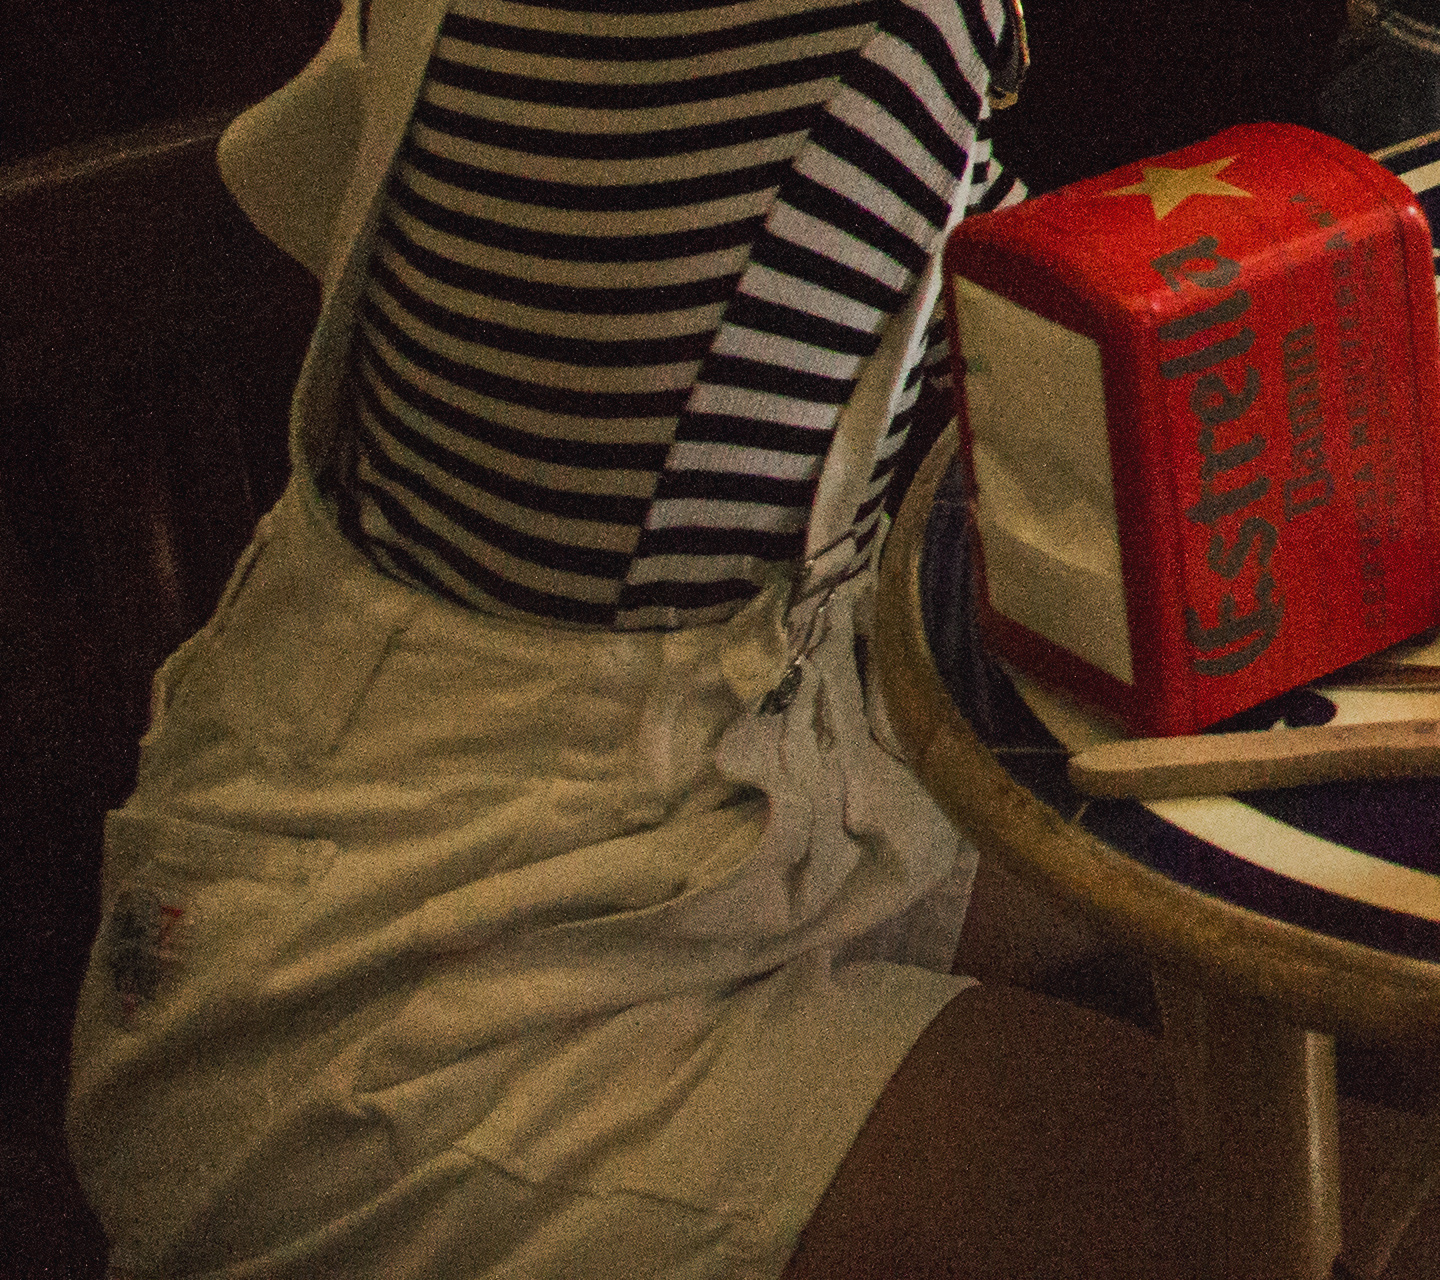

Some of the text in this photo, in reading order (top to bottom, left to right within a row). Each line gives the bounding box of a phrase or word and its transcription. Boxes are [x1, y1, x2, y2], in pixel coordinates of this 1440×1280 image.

[1148, 234, 1286, 678] Estrella
[1281, 321, 1336, 523] Damm
[1350, 461, 1387, 630] CERVESA
